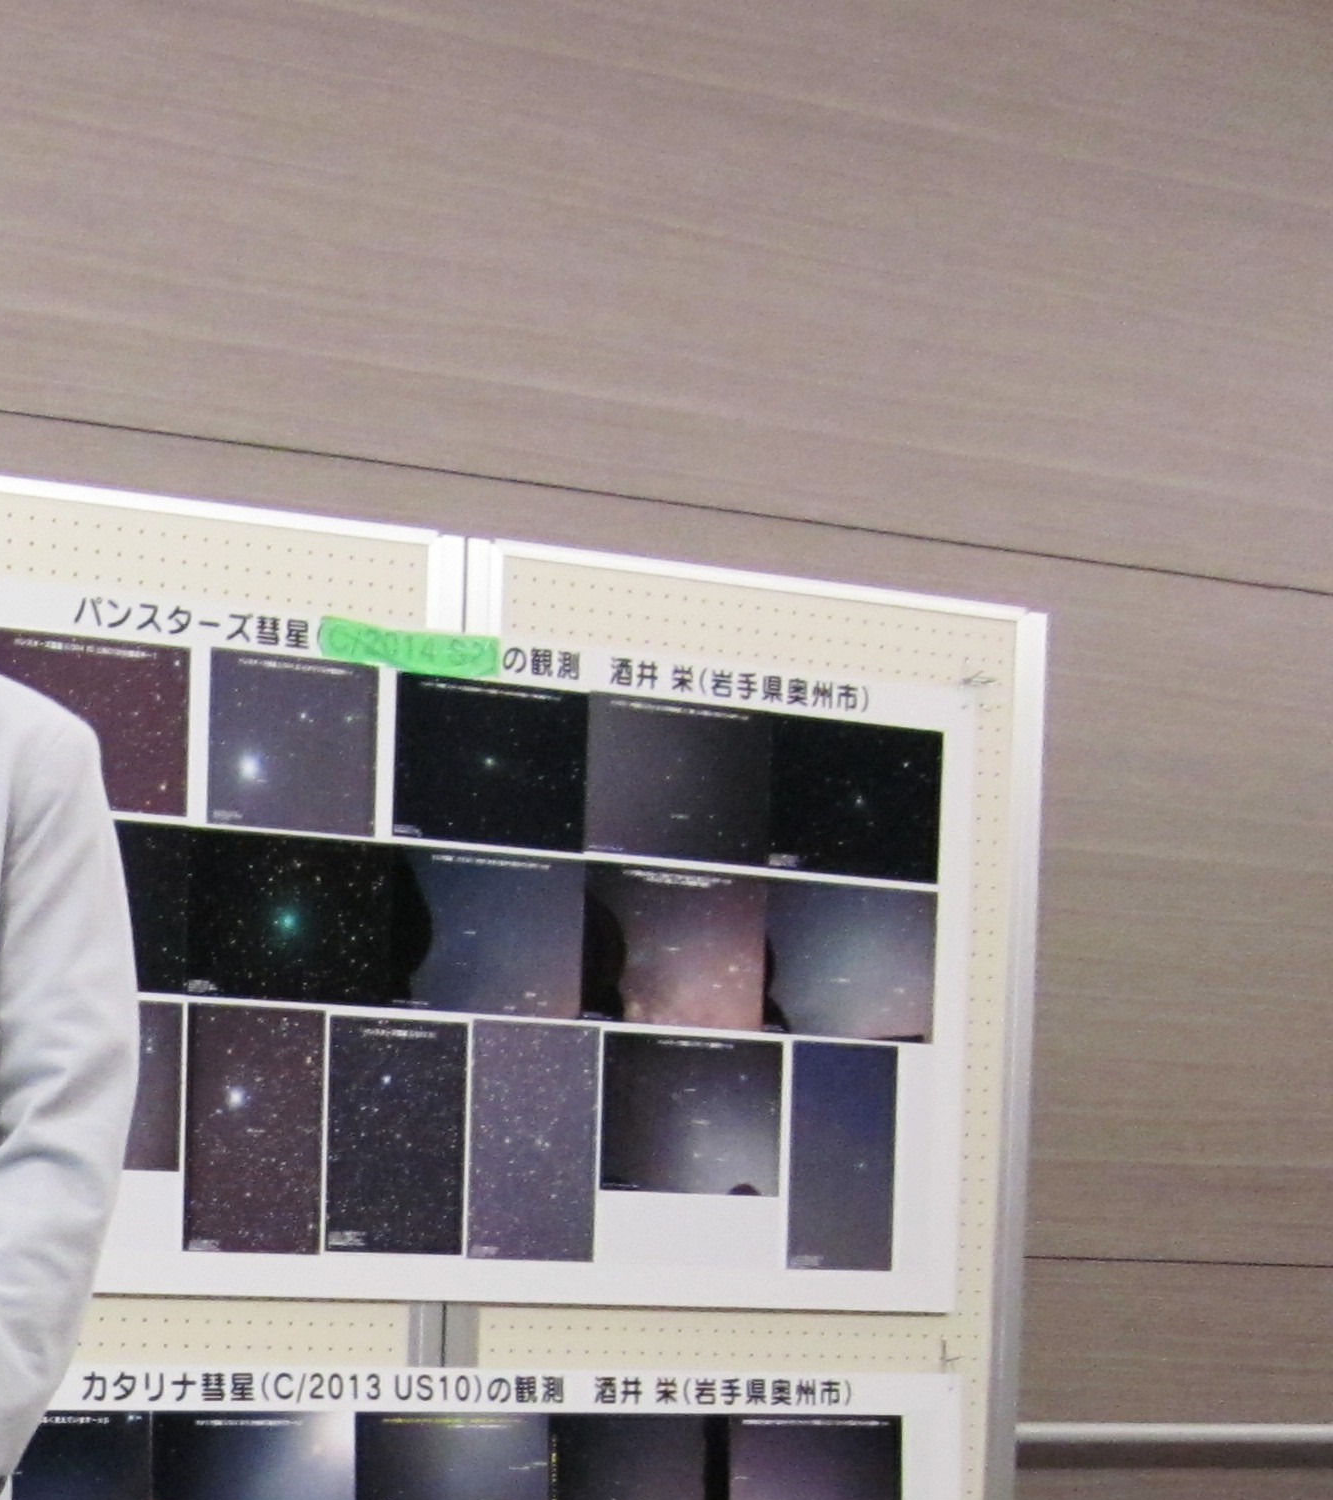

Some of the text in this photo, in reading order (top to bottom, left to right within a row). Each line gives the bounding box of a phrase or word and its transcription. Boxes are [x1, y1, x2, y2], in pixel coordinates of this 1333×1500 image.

[610, 656, 660, 690] 酒井
[671, 662, 871, 714] 栄(岩手県奥州市)
[594, 1375, 644, 1407] 酒井
[655, 1376, 854, 1408] 栄(岩手県奥州市)
